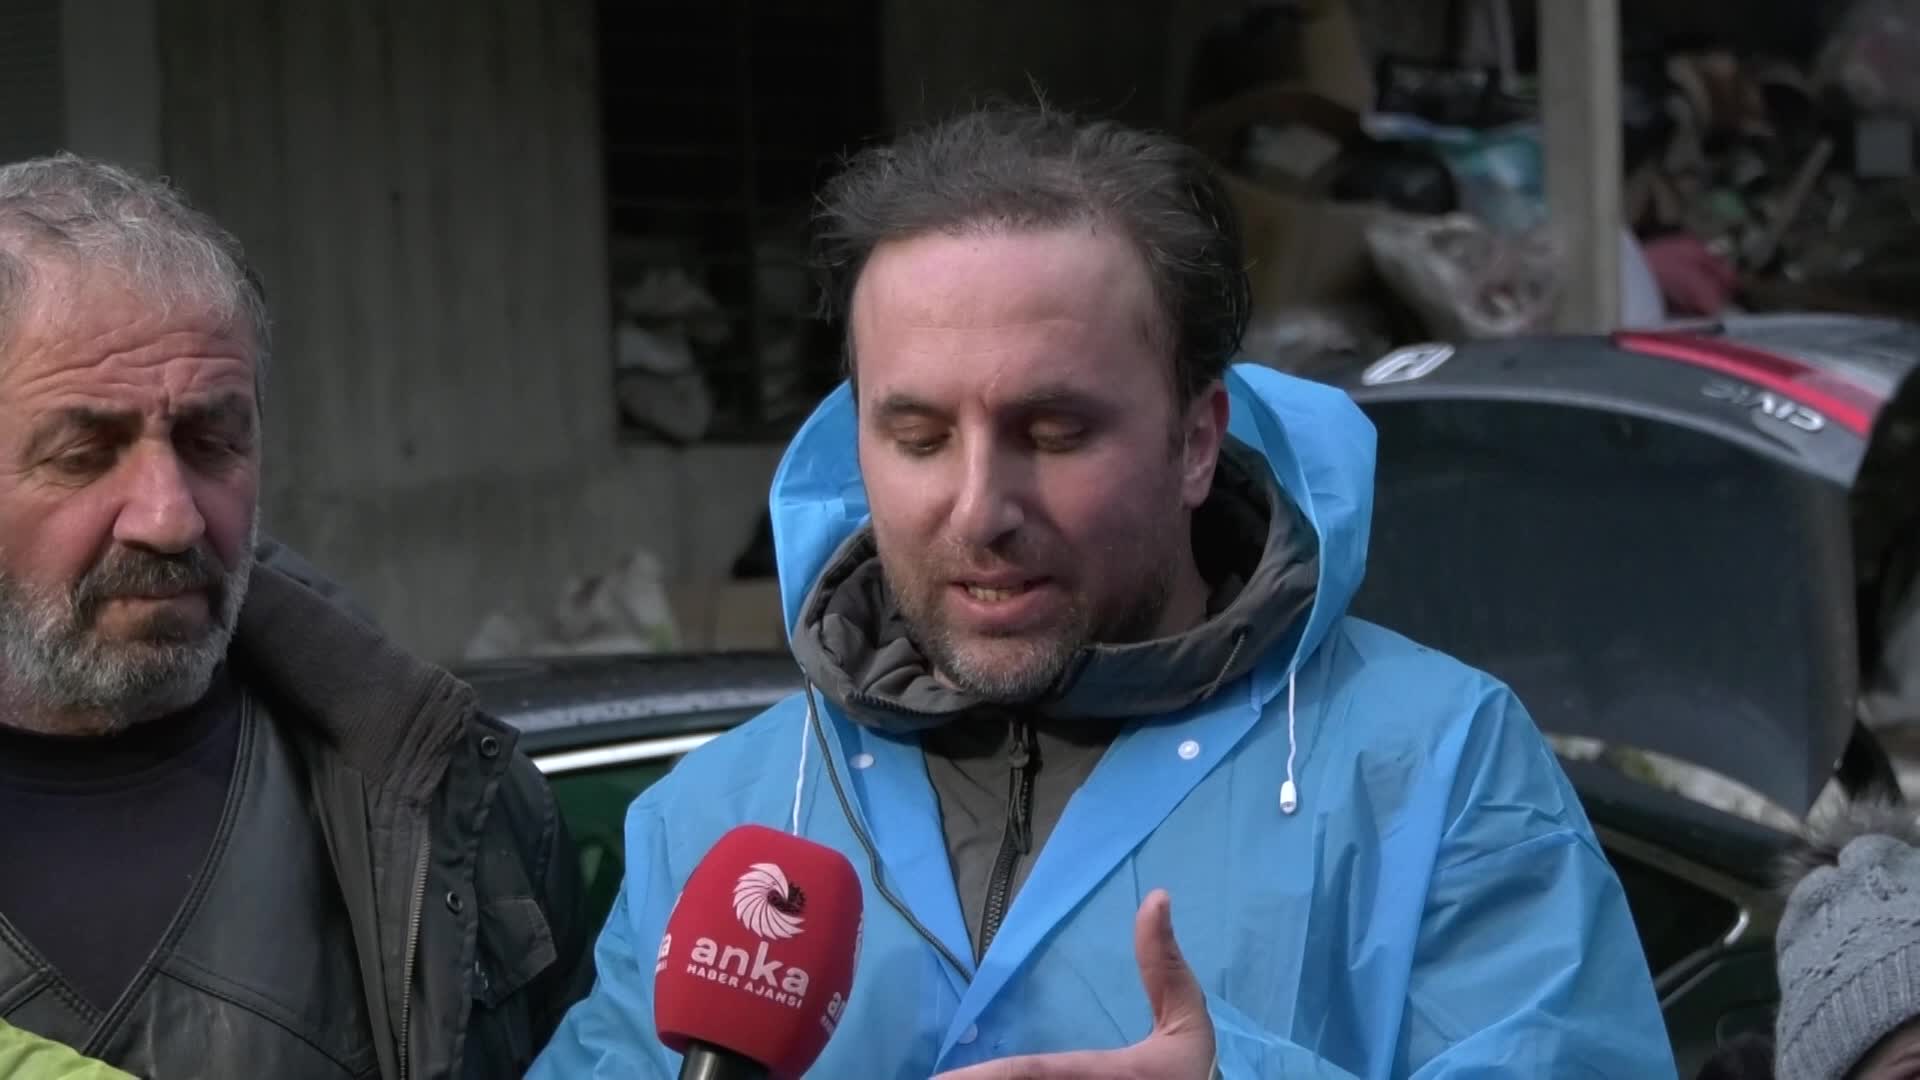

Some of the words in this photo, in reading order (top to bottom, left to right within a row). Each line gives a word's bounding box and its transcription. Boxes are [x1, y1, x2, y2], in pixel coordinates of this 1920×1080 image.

[686, 964, 740, 989] HABER
[743, 982, 803, 1008] AJANSI
[690, 937, 810, 996] anka
